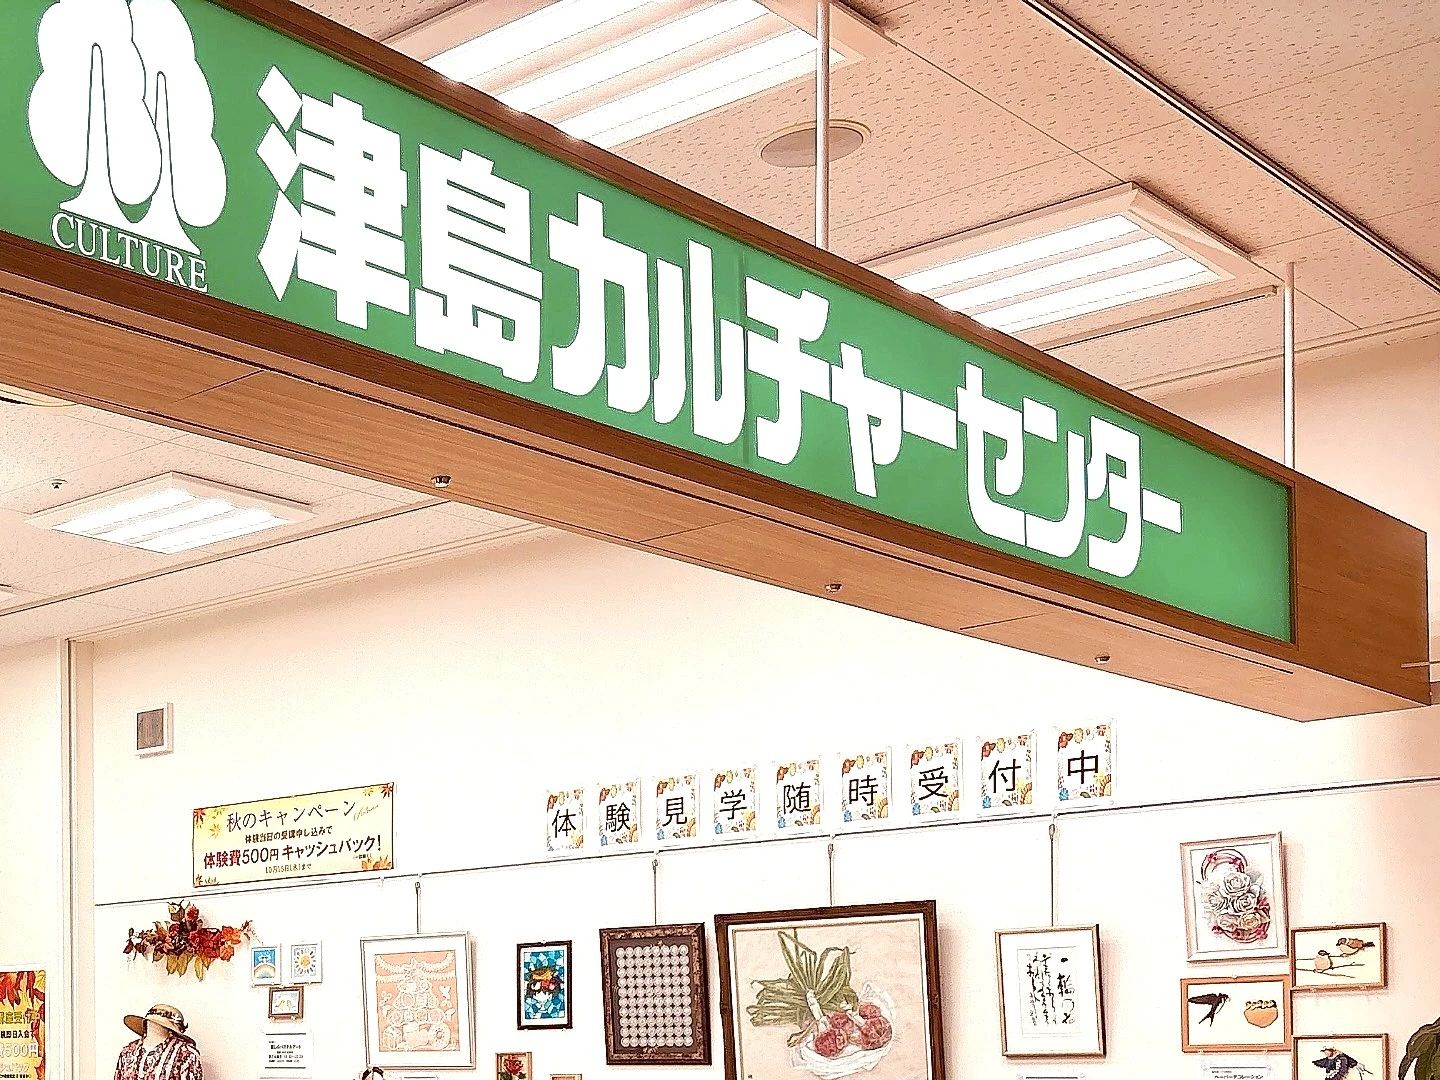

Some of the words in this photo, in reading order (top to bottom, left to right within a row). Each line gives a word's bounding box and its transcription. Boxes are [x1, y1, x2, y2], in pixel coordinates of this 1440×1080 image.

[51, 208, 209, 295] CULTURE
[257, 64, 1183, 579] 津島カルチャーセンター
[227, 800, 356, 833] 秋のキャンペーン
[550, 748, 1102, 840] 体験見学随時受付中
[203, 847, 279, 870] 体験費500円
